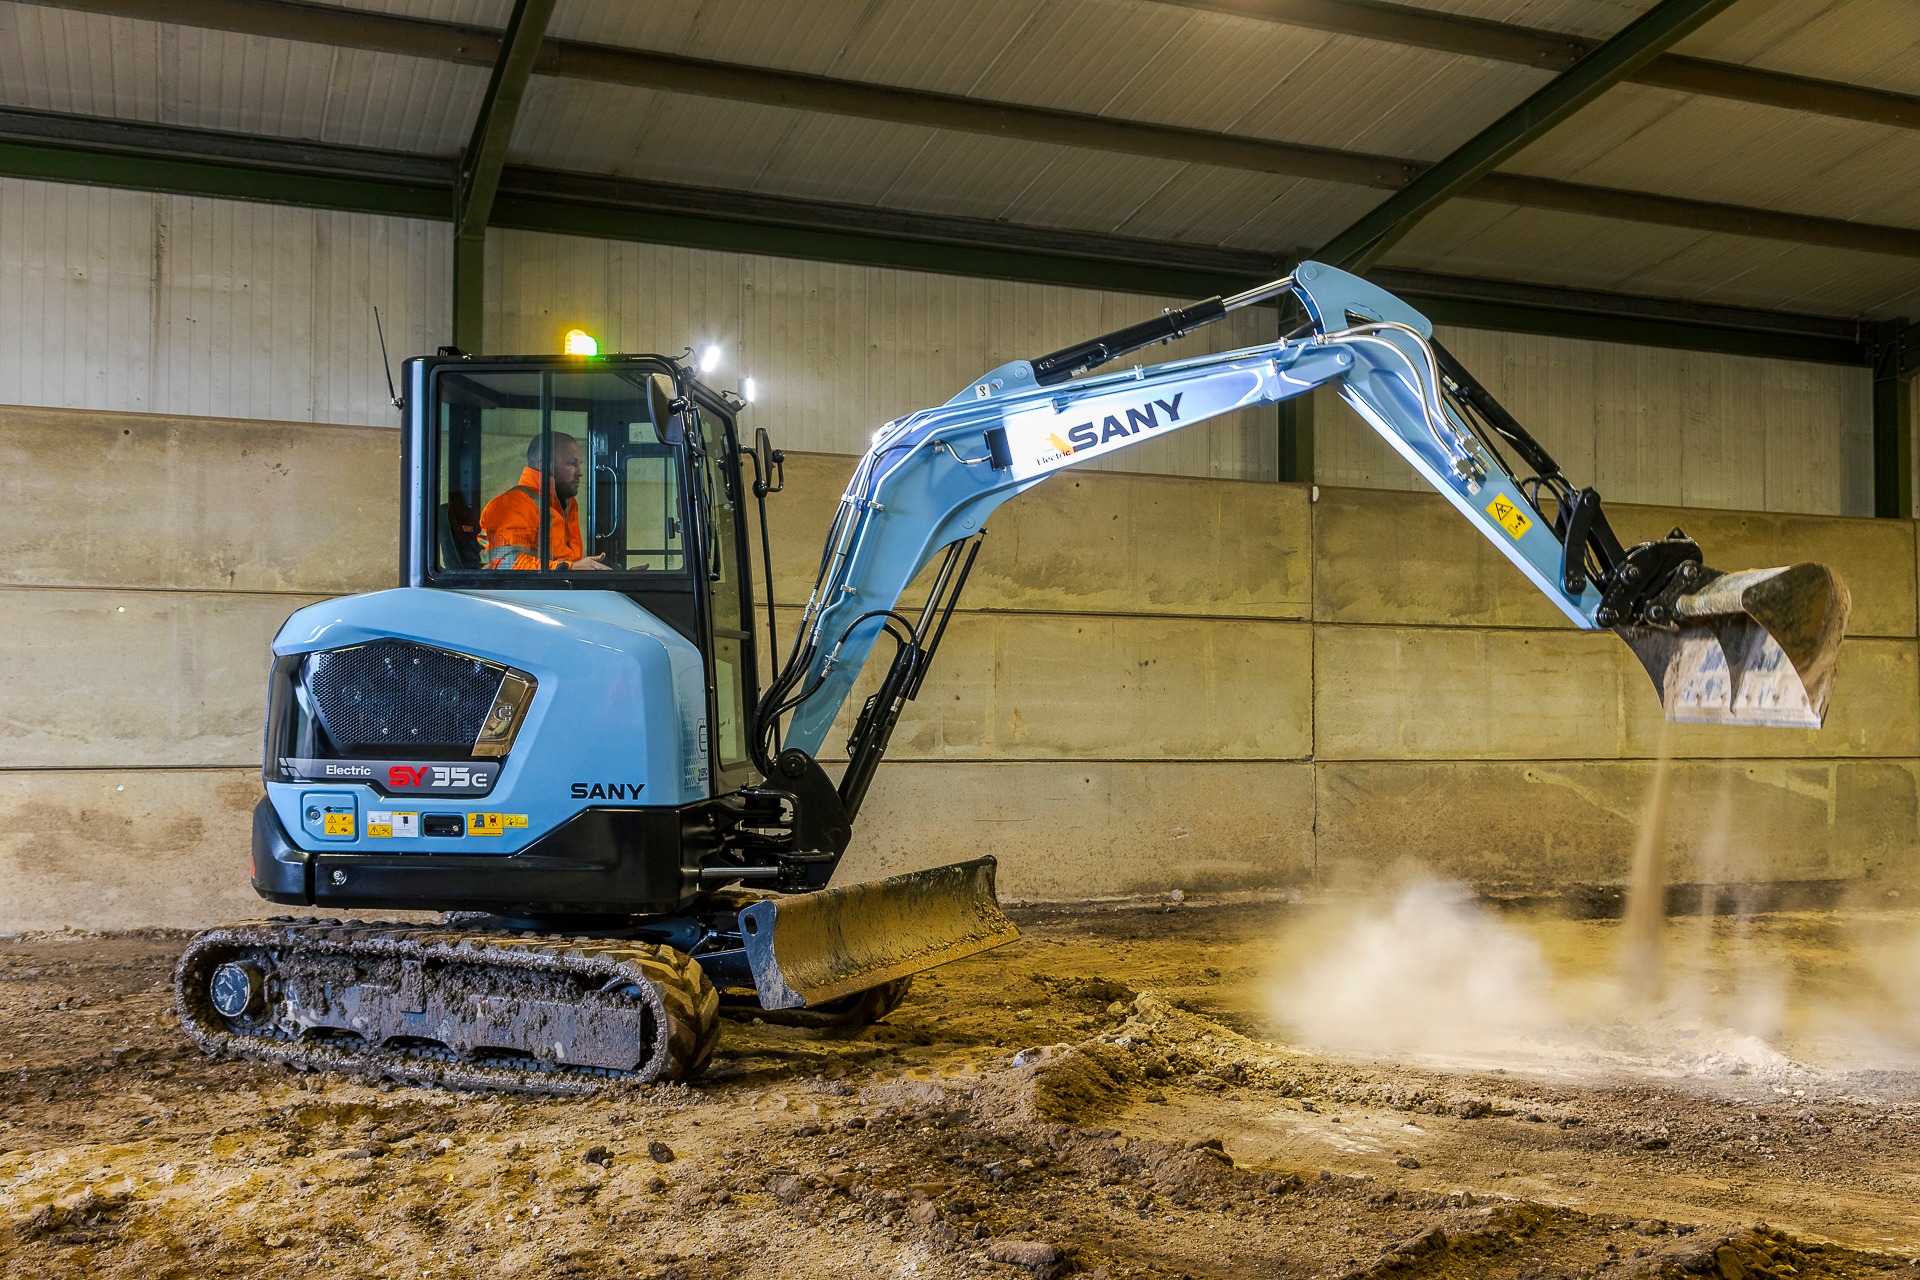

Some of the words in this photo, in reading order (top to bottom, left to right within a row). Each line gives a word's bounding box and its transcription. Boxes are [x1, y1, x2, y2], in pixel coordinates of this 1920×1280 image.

[1068, 392, 1184, 452] SANY
[326, 765, 372, 776] Electric
[571, 783, 645, 800] SANY
